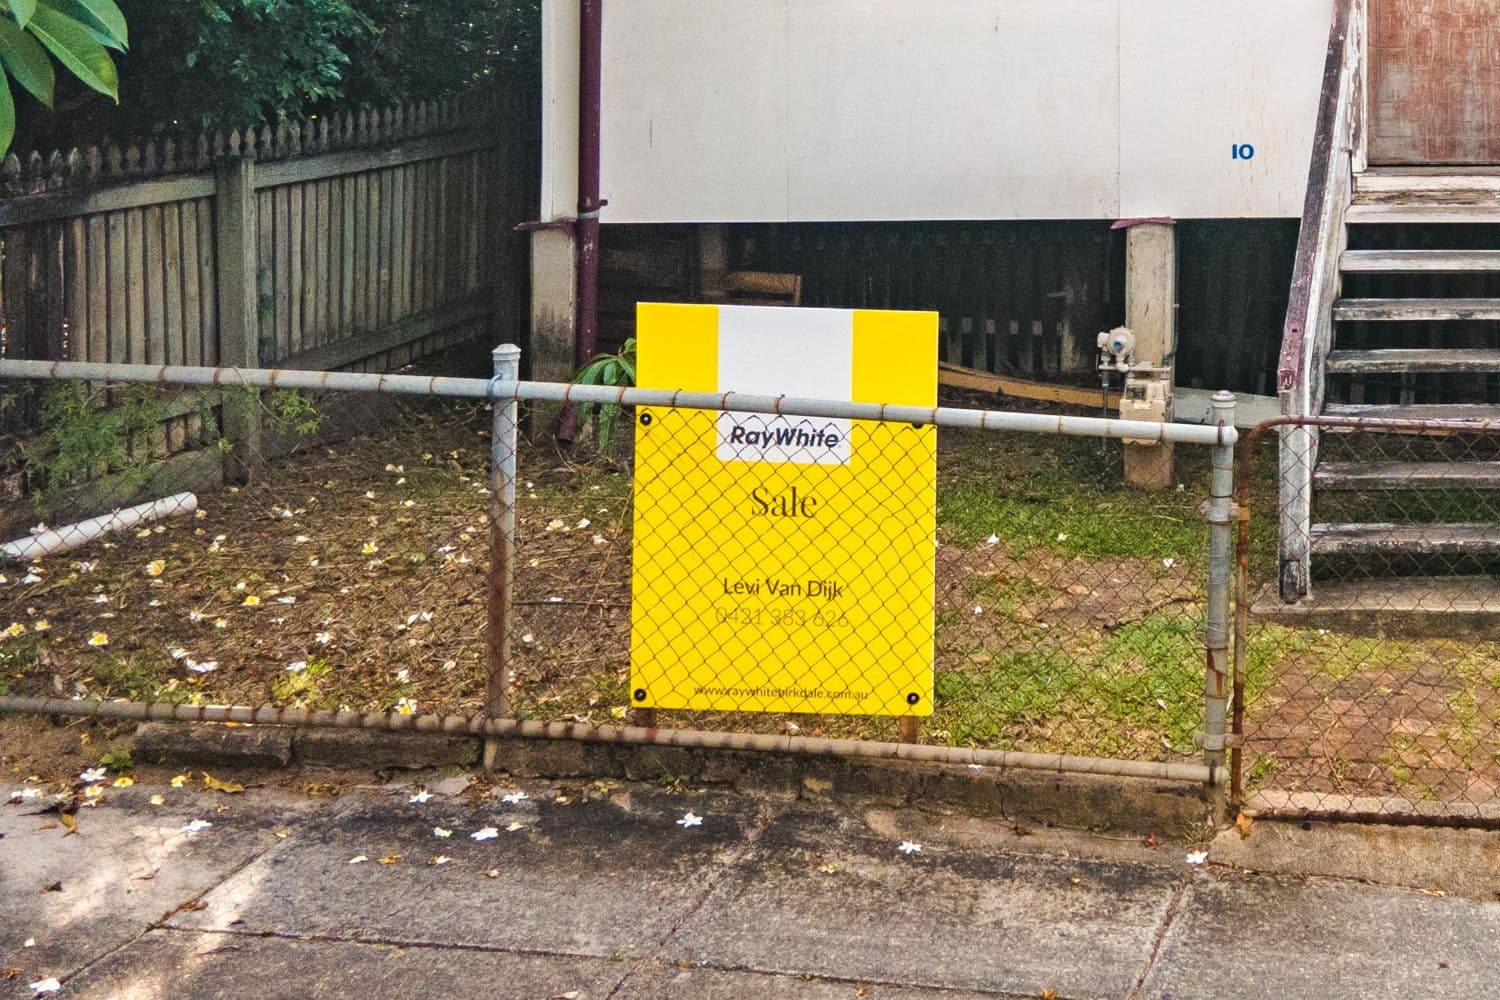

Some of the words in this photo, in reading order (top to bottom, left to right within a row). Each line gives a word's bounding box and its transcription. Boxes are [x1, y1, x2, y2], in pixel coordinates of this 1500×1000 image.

[752, 486, 817, 518] Sale
[723, 577, 760, 595] Levi
[766, 579, 801, 596] Van
[807, 580, 843, 601] Dijk
[715, 607, 762, 625] 0421
